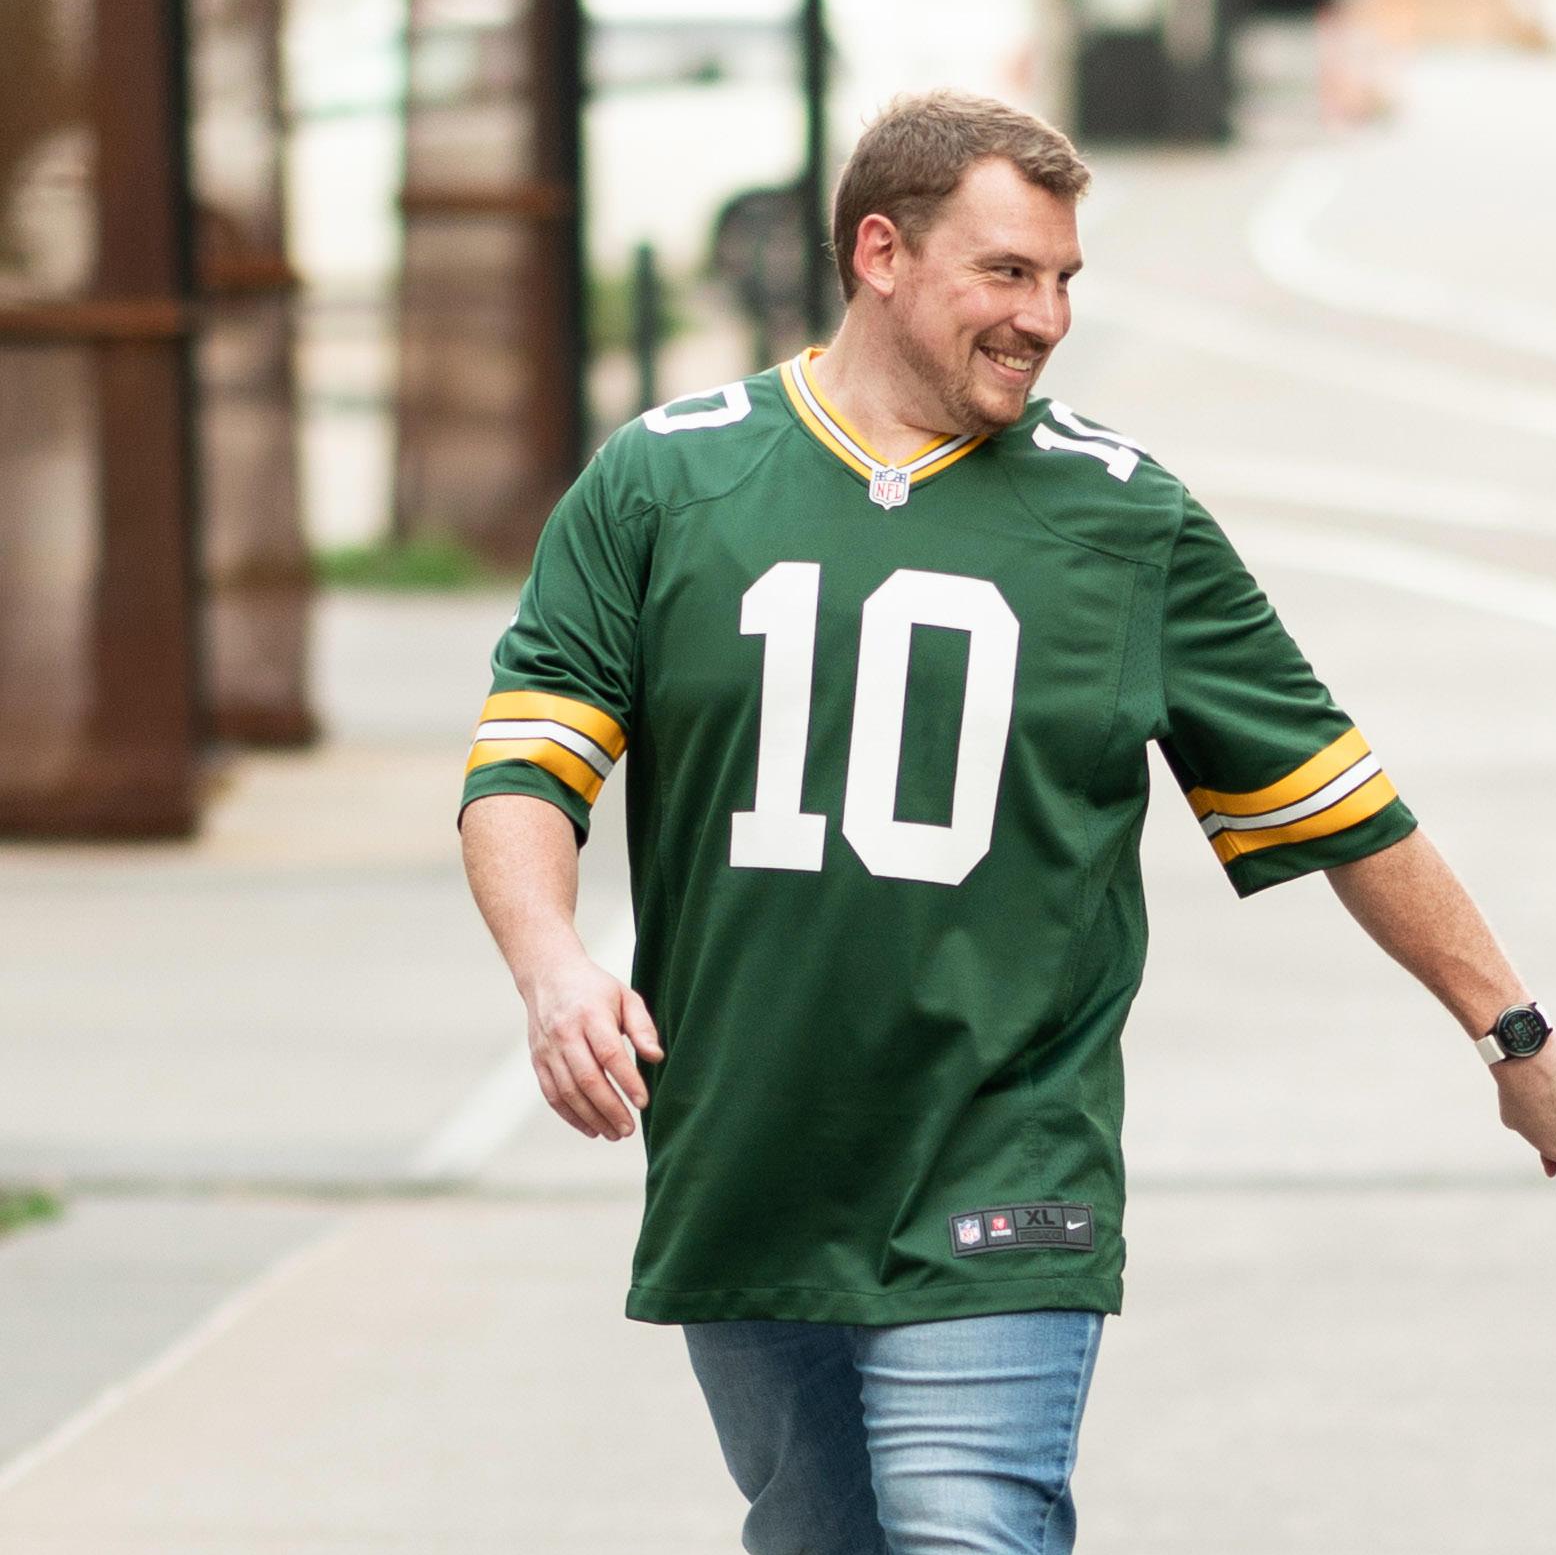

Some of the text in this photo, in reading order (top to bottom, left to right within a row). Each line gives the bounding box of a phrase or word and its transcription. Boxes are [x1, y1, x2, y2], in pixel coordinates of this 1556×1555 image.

[876, 481, 902, 500] NFL
[729, 561, 1020, 886] 10
[1025, 1210, 1055, 1225] XL
